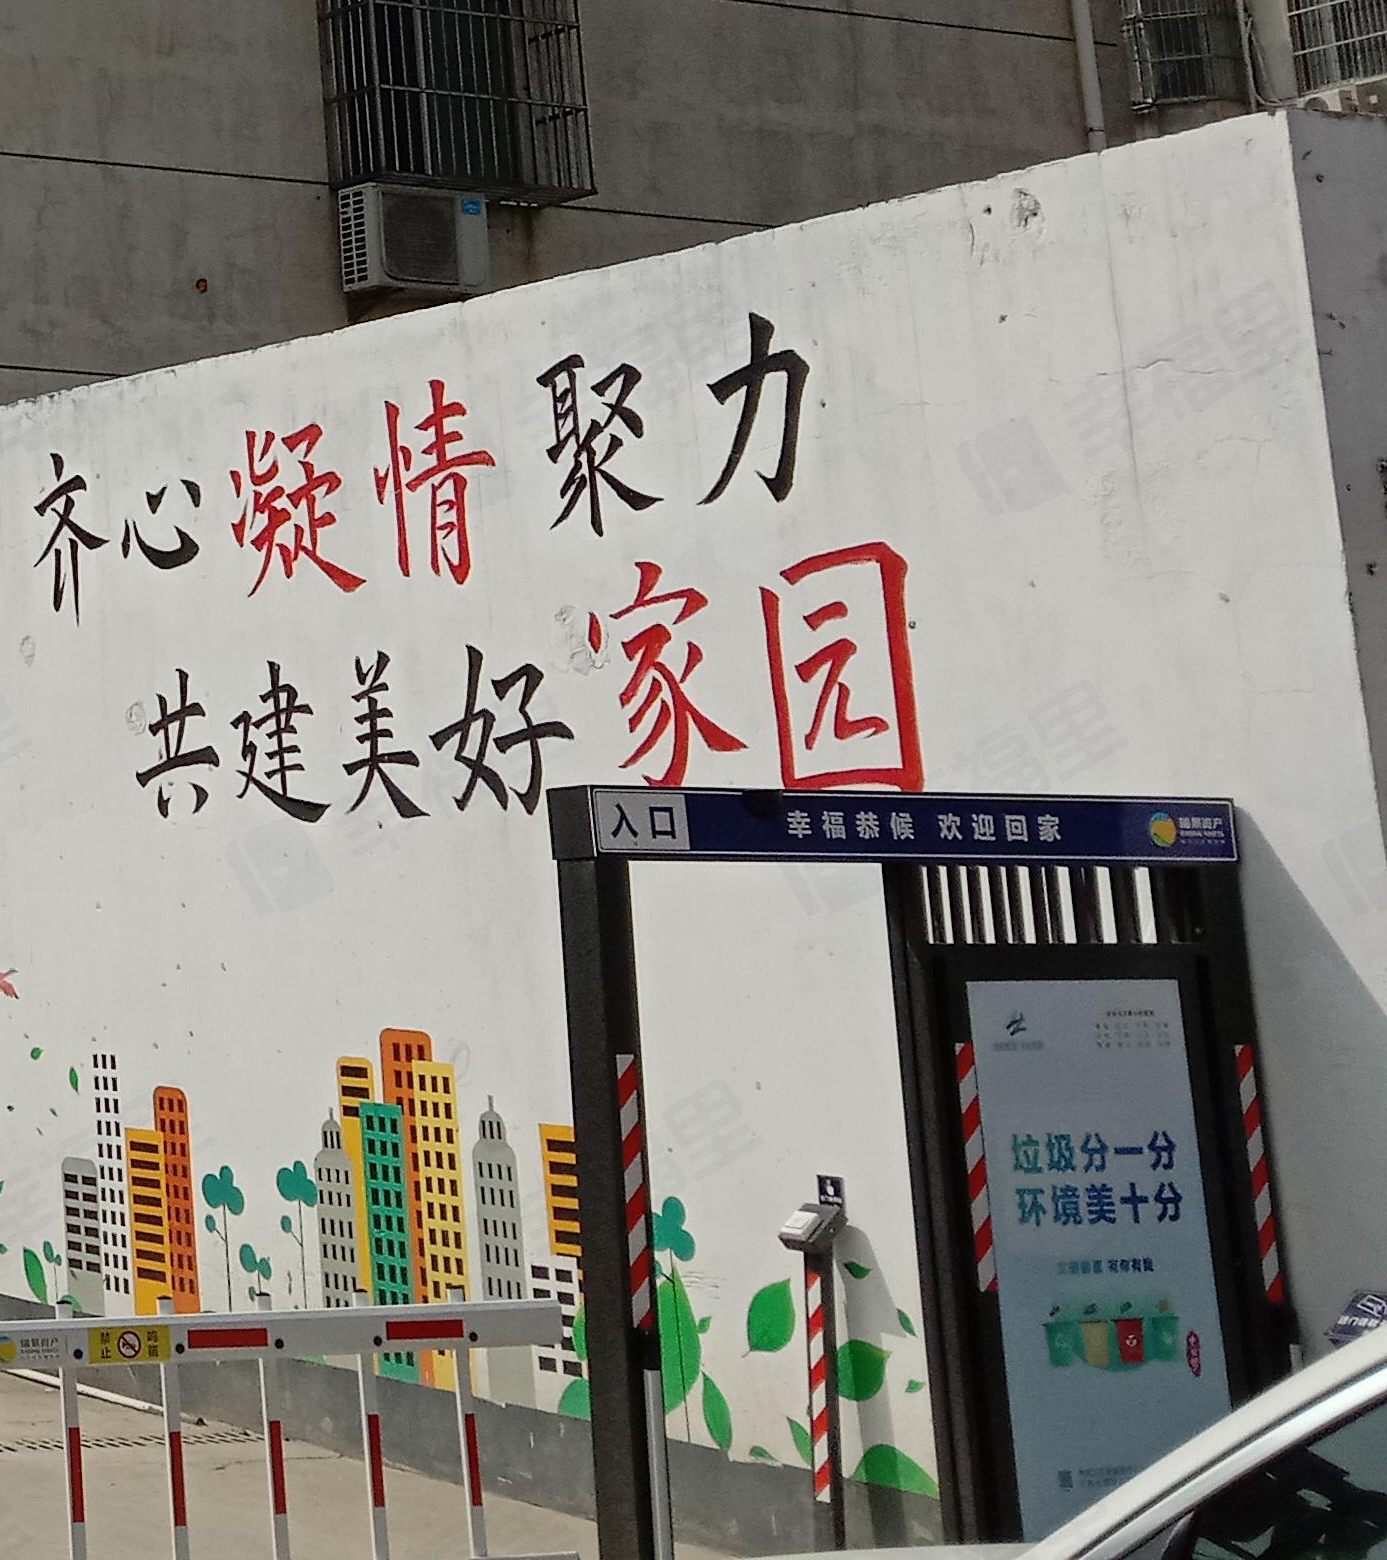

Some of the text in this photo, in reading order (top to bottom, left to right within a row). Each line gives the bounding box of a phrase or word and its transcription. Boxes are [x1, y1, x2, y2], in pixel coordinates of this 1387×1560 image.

[33, 311, 812, 626] 齐心凝情聚力
[135, 541, 926, 822] 共建美好家园
[610, 804, 675, 840] 入口
[787, 810, 1063, 843] 幸福恭候 欢迎回家
[1011, 1130, 1176, 1175] 垃圾分一分
[1015, 1181, 1183, 1228] 环境美十分
